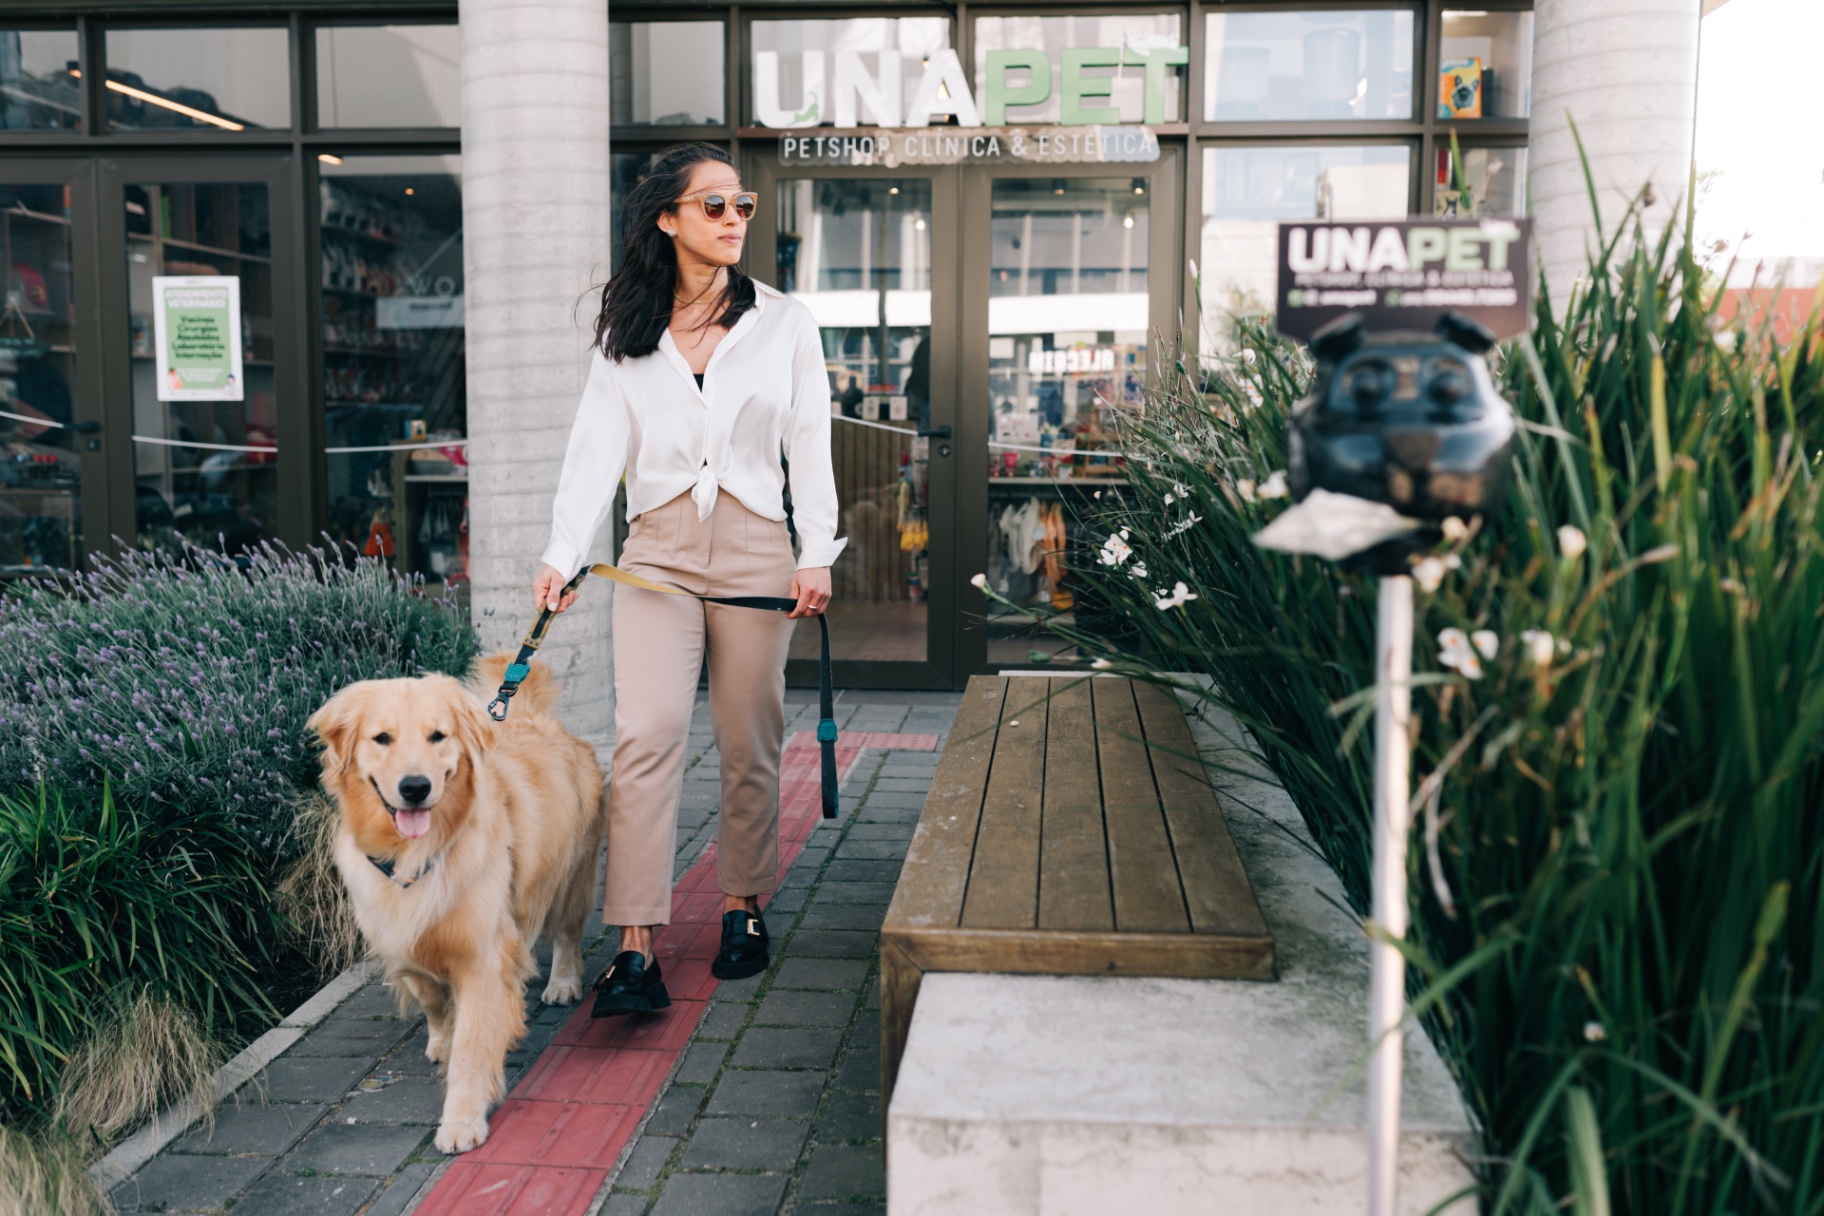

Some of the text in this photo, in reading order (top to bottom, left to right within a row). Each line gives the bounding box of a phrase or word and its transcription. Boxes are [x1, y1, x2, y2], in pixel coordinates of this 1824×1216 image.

[756, 46, 1189, 128] UNAPET
[783, 131, 1152, 160] PETSHOP, CLÍNICA & ESTÉTICA
[1288, 226, 1521, 272] UNAPET
